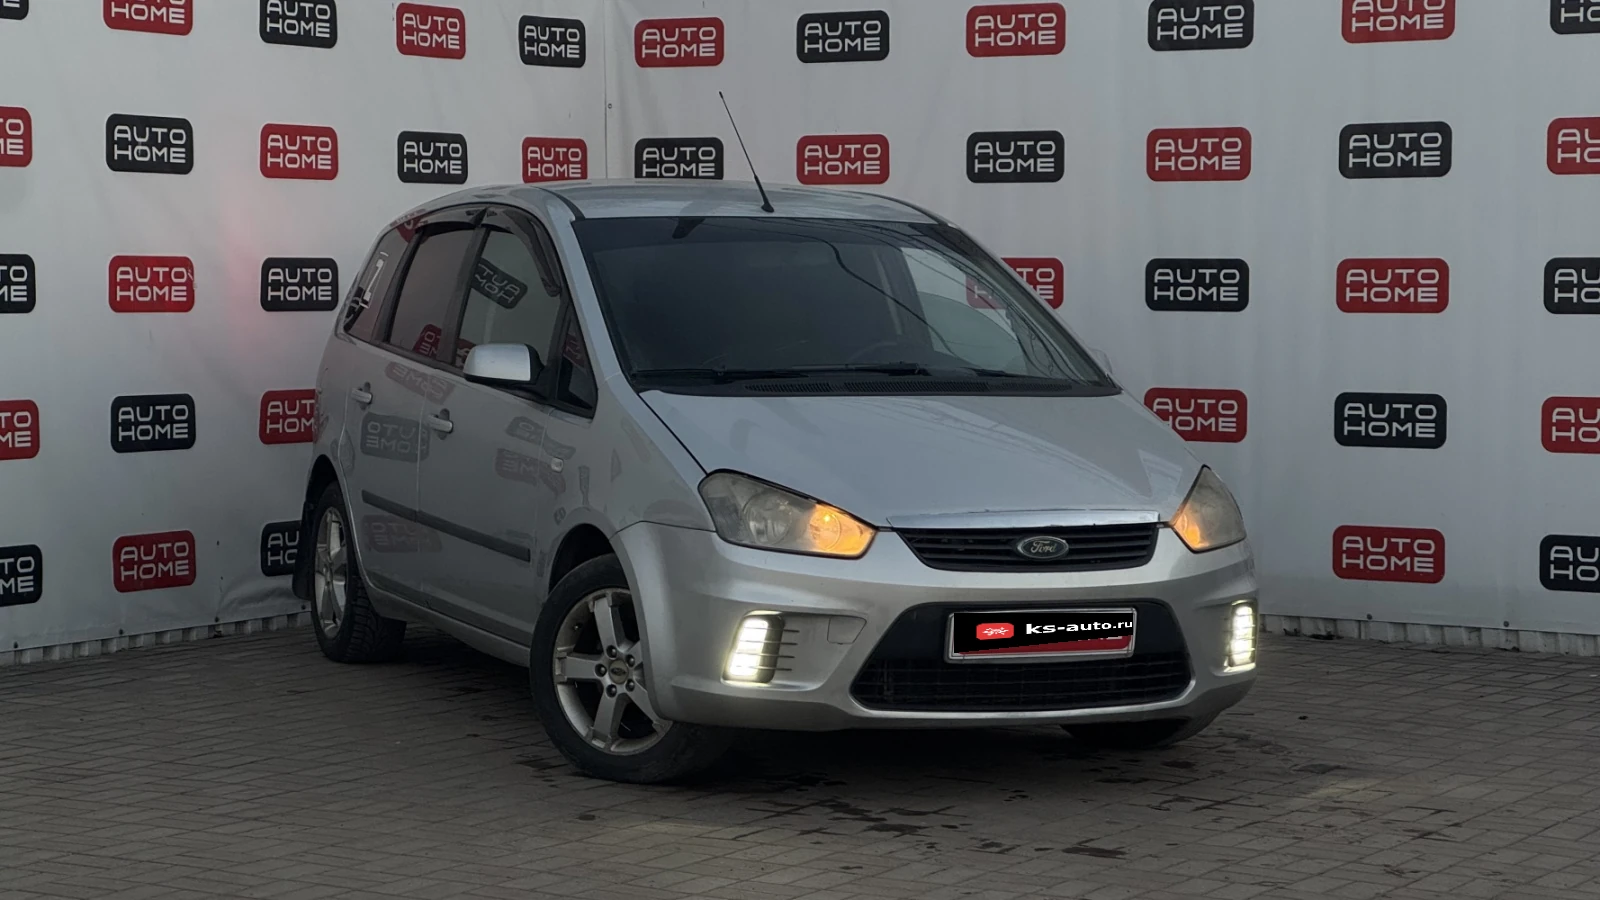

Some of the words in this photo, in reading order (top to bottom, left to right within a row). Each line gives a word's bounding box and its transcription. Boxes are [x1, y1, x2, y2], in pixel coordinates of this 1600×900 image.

[111, 1, 185, 24] HOME
[266, 0, 331, 19] AUTO
[1157, 5, 1245, 23] AUTO
[1352, 0, 1445, 14] AUTO
[1561, 6, 1600, 23] HO
[266, 17, 331, 37] HOME
[402, 13, 460, 33] AUTO
[804, 20, 882, 37] AUTO
[974, 12, 1057, 30] AUTO
[1351, 13, 1444, 32] HOME
[402, 30, 460, 50] HOME
[523, 25, 580, 42] AUTO
[641, 26, 717, 42] AUTO
[974, 29, 1056, 48] HOME
[1157, 23, 1243, 41] HOME
[523, 42, 580, 59] HOME
[641, 42, 716, 58] HOME
[804, 37, 881, 53] HOME
[113, 125, 187, 145] AUTO
[267, 134, 332, 152] AUTO
[1349, 132, 1443, 149] AUTO
[1558, 129, 1600, 144] AU
[403, 141, 463, 158] AUTO
[804, 143, 881, 158] AUTO
[974, 140, 1056, 157] AUTO
[1155, 137, 1242, 153] AUTO
[113, 144, 187, 164] HOME
[267, 153, 332, 170] HOME
[527, 146, 582, 162] AUTO
[643, 147, 716, 161] AUTO
[1349, 151, 1441, 168] HOME
[1557, 147, 1600, 163] HO
[403, 158, 462, 175] HOME
[527, 163, 582, 178] HOME
[642, 163, 715, 177] HOME
[804, 160, 881, 175] HOME
[974, 157, 1055, 173] HOME
[1155, 155, 1240, 171] HOME
[116, 266, 187, 283] AUTO
[268, 267, 333, 283] AUTO
[1015, 268, 1055, 282] TO
[1154, 268, 1240, 284] AUTO
[1346, 268, 1440, 284] AUTO
[1555, 268, 1600, 284] AU
[116, 285, 187, 302] HOME
[267, 285, 332, 301] HOME
[1154, 286, 1239, 301] HOME
[1346, 287, 1438, 302] HOME
[1554, 287, 1600, 303] HO
[118, 404, 189, 423] AUTO
[267, 399, 315, 416] AUT
[1153, 398, 1238, 415] AUTO
[1344, 403, 1437, 420] AUTO
[0, 411, 32, 429] TO
[1552, 408, 1600, 423] AU
[118, 423, 189, 442] HOME
[266, 417, 315, 434] HOM
[1344, 421, 1436, 438] HOME
[1552, 426, 1600, 442] HO
[0, 430, 31, 448] ME
[268, 531, 299, 548] AU
[1030, 540, 1057, 553] Ford
[1342, 535, 1436, 555] AUTO
[120, 541, 189, 563] AUTO
[268, 549, 298, 566] HO
[1550, 546, 1600, 562] AU
[0, 556, 35, 575] TO
[120, 559, 189, 582] HOME
[1342, 554, 1434, 573] HOME
[1550, 564, 1600, 581] HO
[0, 575, 34, 595] ME
